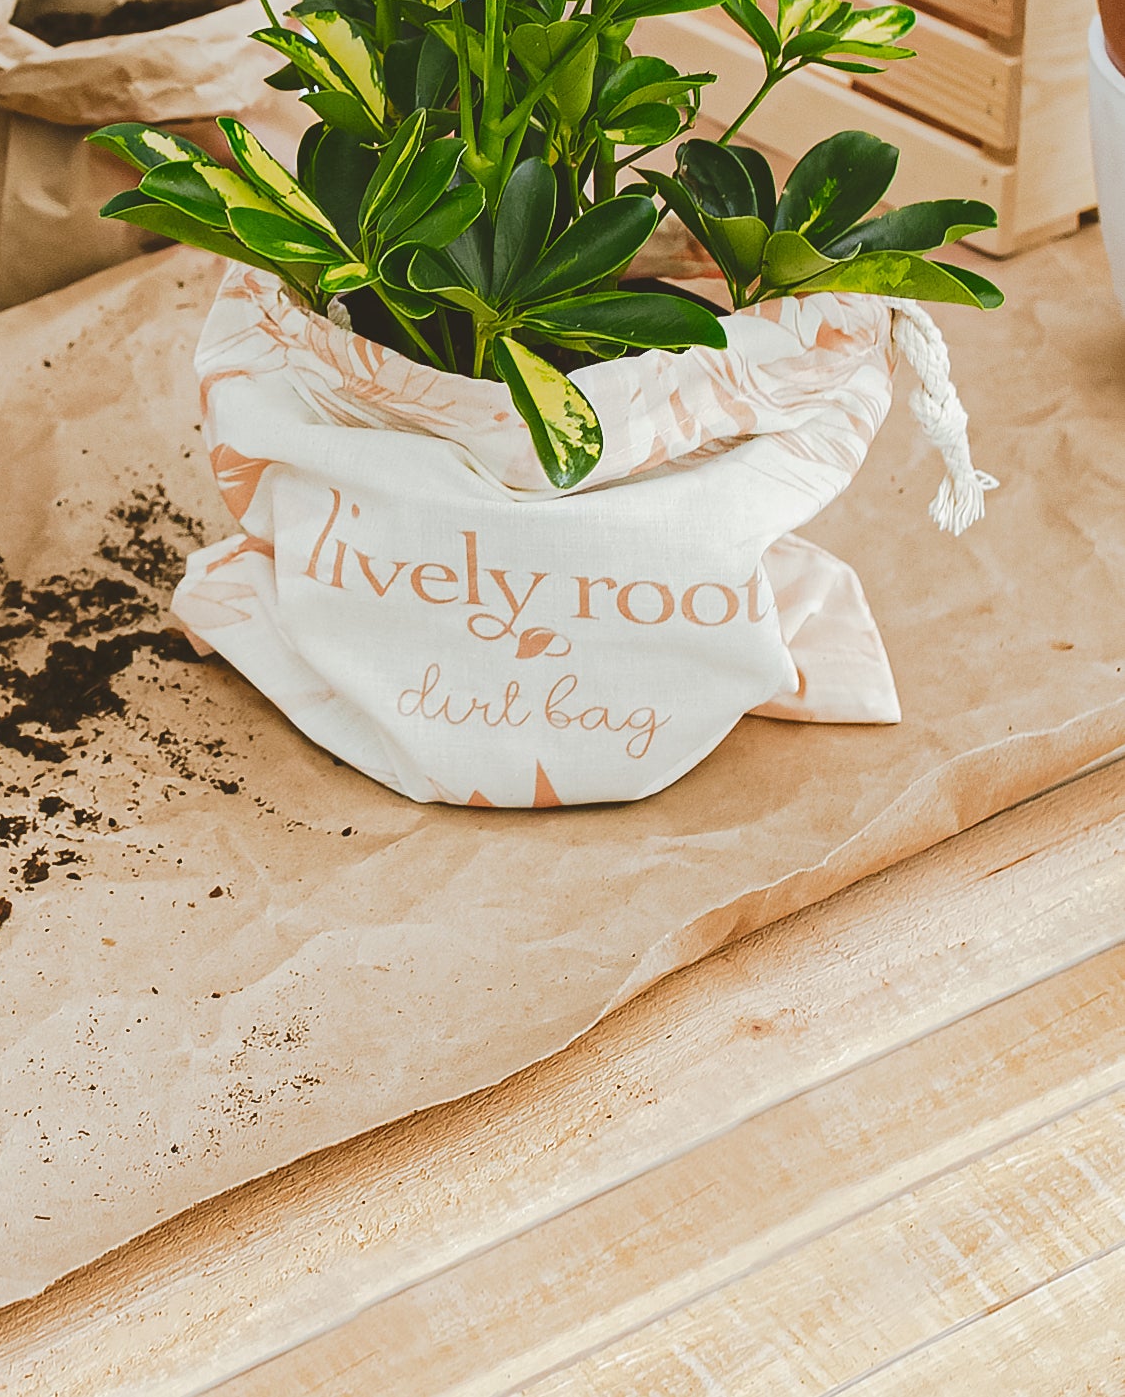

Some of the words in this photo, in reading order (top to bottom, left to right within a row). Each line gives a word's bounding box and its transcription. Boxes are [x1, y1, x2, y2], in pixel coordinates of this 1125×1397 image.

[302, 488, 550, 641] lively
[570, 564, 775, 627] root
[397, 662, 532, 727] dirt
[545, 674, 672, 760] bag
